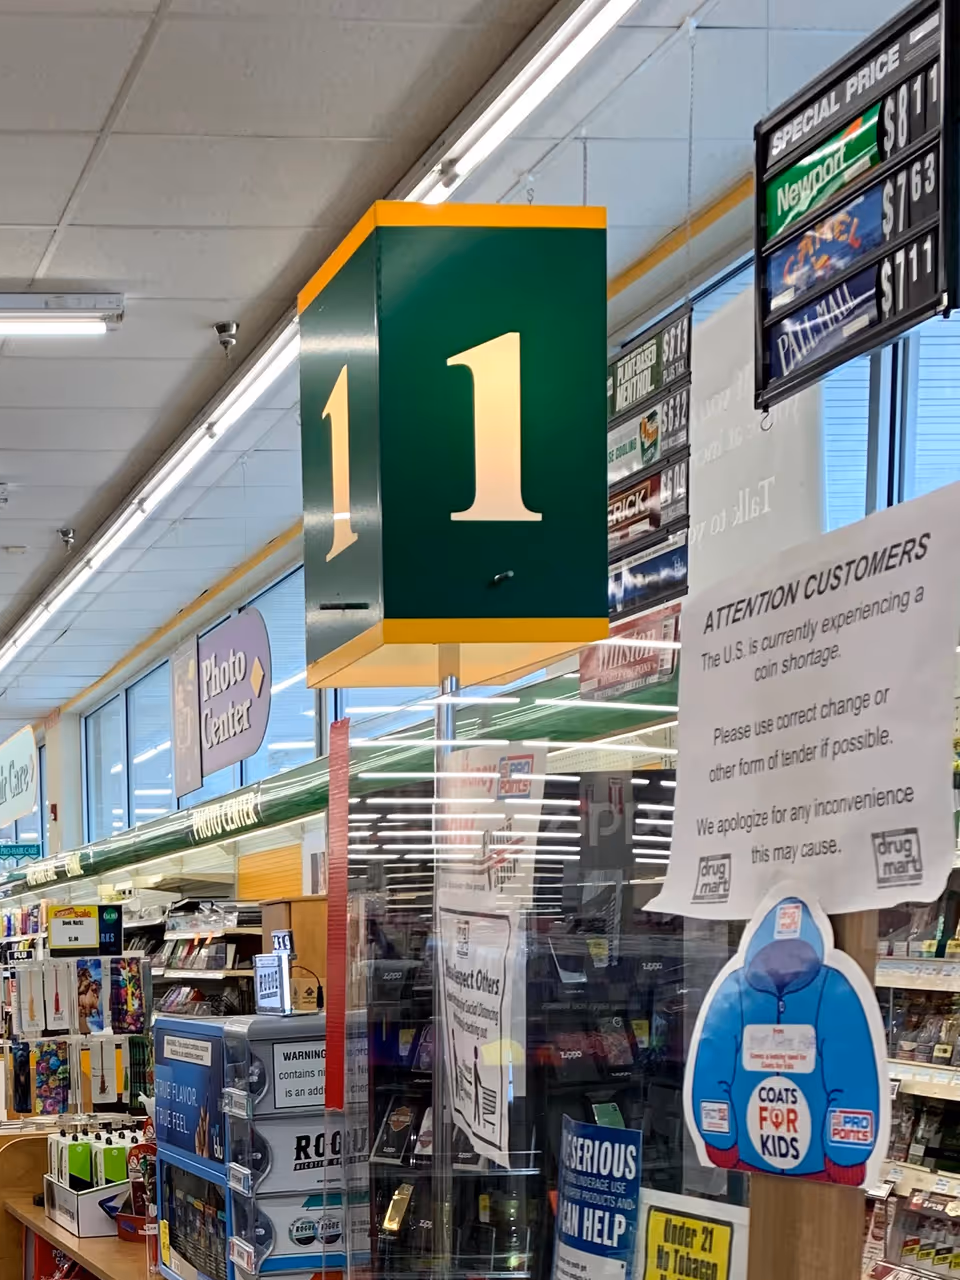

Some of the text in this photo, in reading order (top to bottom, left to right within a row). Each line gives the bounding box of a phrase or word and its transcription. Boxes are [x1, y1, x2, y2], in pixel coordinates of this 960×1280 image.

[772, 44, 900, 155] SPECIAL PRICE
[777, 145, 847, 216] Newport
[784, 213, 861, 286] CAMEL
[777, 284, 855, 376] PALL MALL
[447, 332, 543, 521] 1
[322, 364, 359, 562] 1
[703, 532, 932, 634] ATTENTION CUSTOMERS
[702, 588, 925, 672] The U.S. is currently experiencing a
[599, 629, 656, 672] Winston
[754, 643, 841, 682] coin shortage.
[201, 649, 246, 701] Photo
[202, 699, 252, 748] Center
[714, 687, 890, 746] Please use correct change or
[709, 726, 893, 783] other form of tender if possible.
[9, 760, 29, 803] Care
[499, 780, 531, 796] POINTS
[192, 791, 258, 840] PHOTO CENTER
[697, 784, 914, 836] We apologize for any inconvenience
[751, 838, 842, 866] this may cause.
[877, 834, 920, 877] drug mart
[700, 856, 729, 895] drug mart
[14, 952, 27, 960] FLU
[278, 1070, 316, 1081] contains
[283, 1050, 326, 1062] WARNING
[285, 1088, 305, 1098] is an
[758, 1087, 798, 1104] COATS
[156, 1107, 171, 1128] TRUE
[759, 1107, 798, 1133] FOR
[832, 1128, 869, 1143] POINTS
[843, 1115, 869, 1129] PRO
[571, 1135, 637, 1180] SERIOUS
[760, 1134, 800, 1160] KIDS
[582, 1190, 616, 1208] PRODUCTS
[611, 1180, 627, 1195] USE
[583, 1208, 626, 1247] HELP
[664, 1218, 714, 1254] Under 21
[657, 1244, 669, 1271] No
